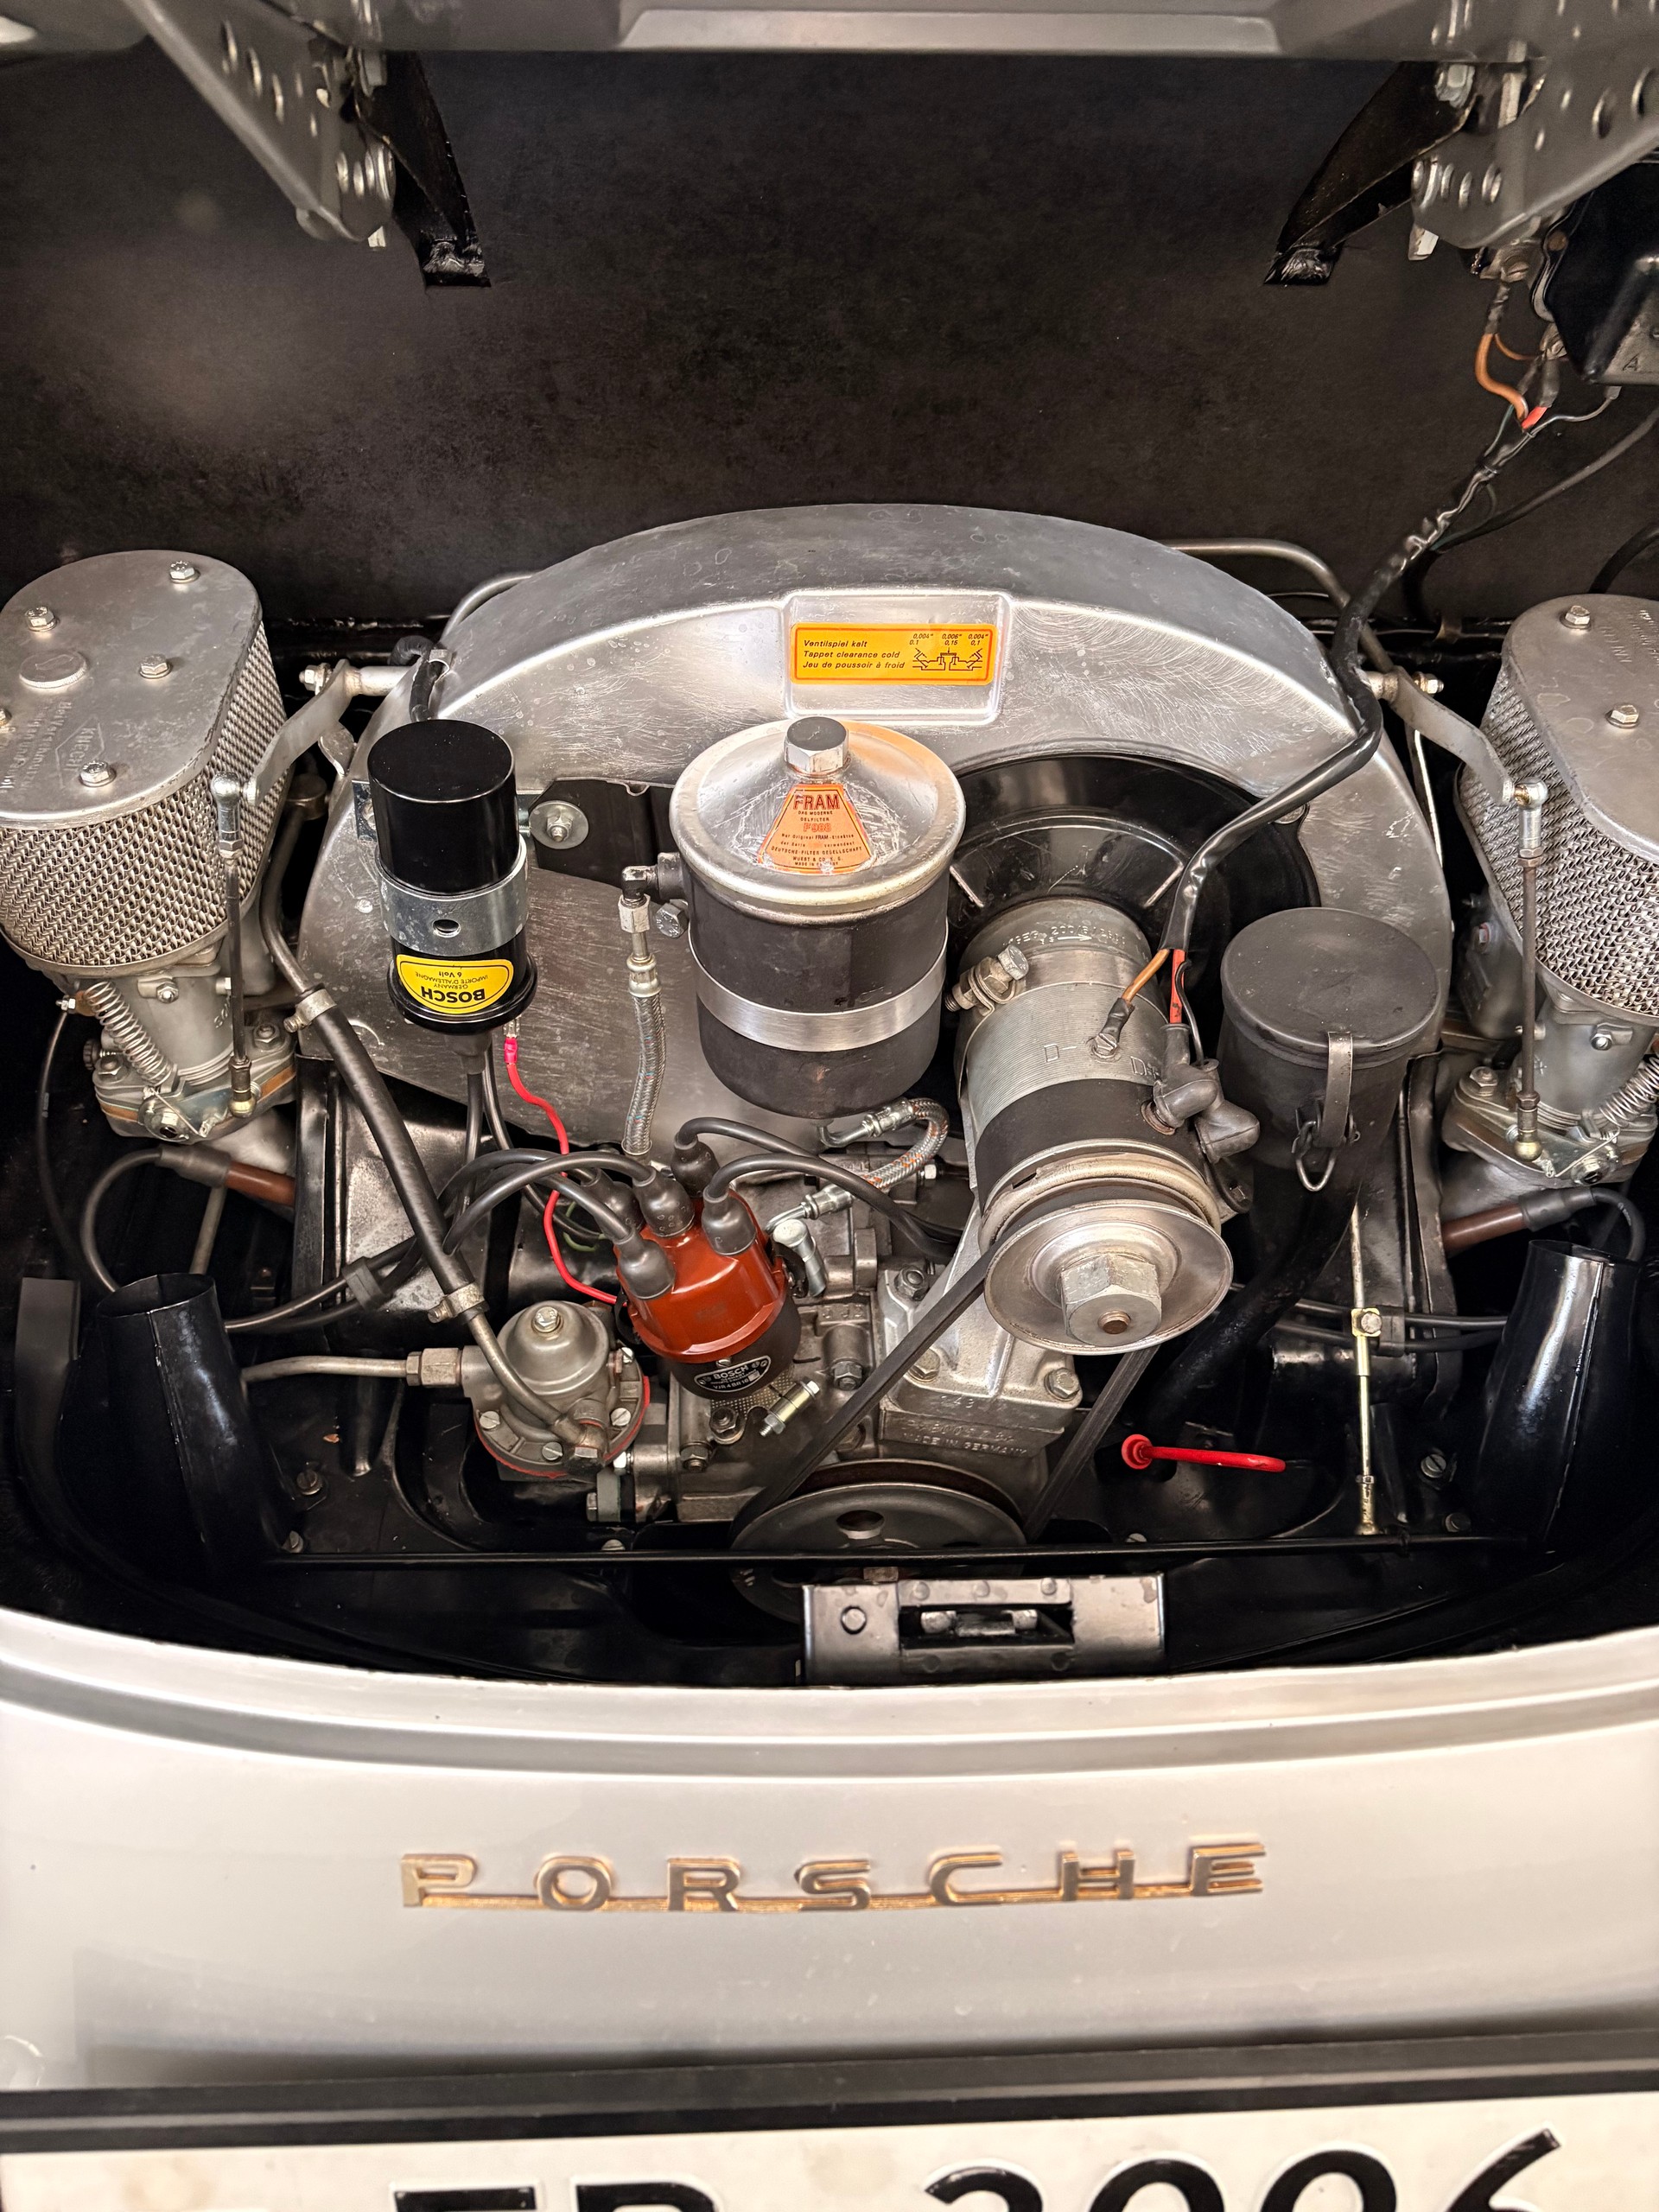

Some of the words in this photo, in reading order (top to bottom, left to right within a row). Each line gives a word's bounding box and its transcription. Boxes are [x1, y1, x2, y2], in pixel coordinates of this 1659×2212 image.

[804, 639, 849, 648] Ventilspiel
[792, 794, 841, 810] FRAM
[421, 986, 486, 1003] BOSCH
[714, 1365, 749, 1379] BOSCH
[401, 1842, 1267, 1913] PORSCHE
